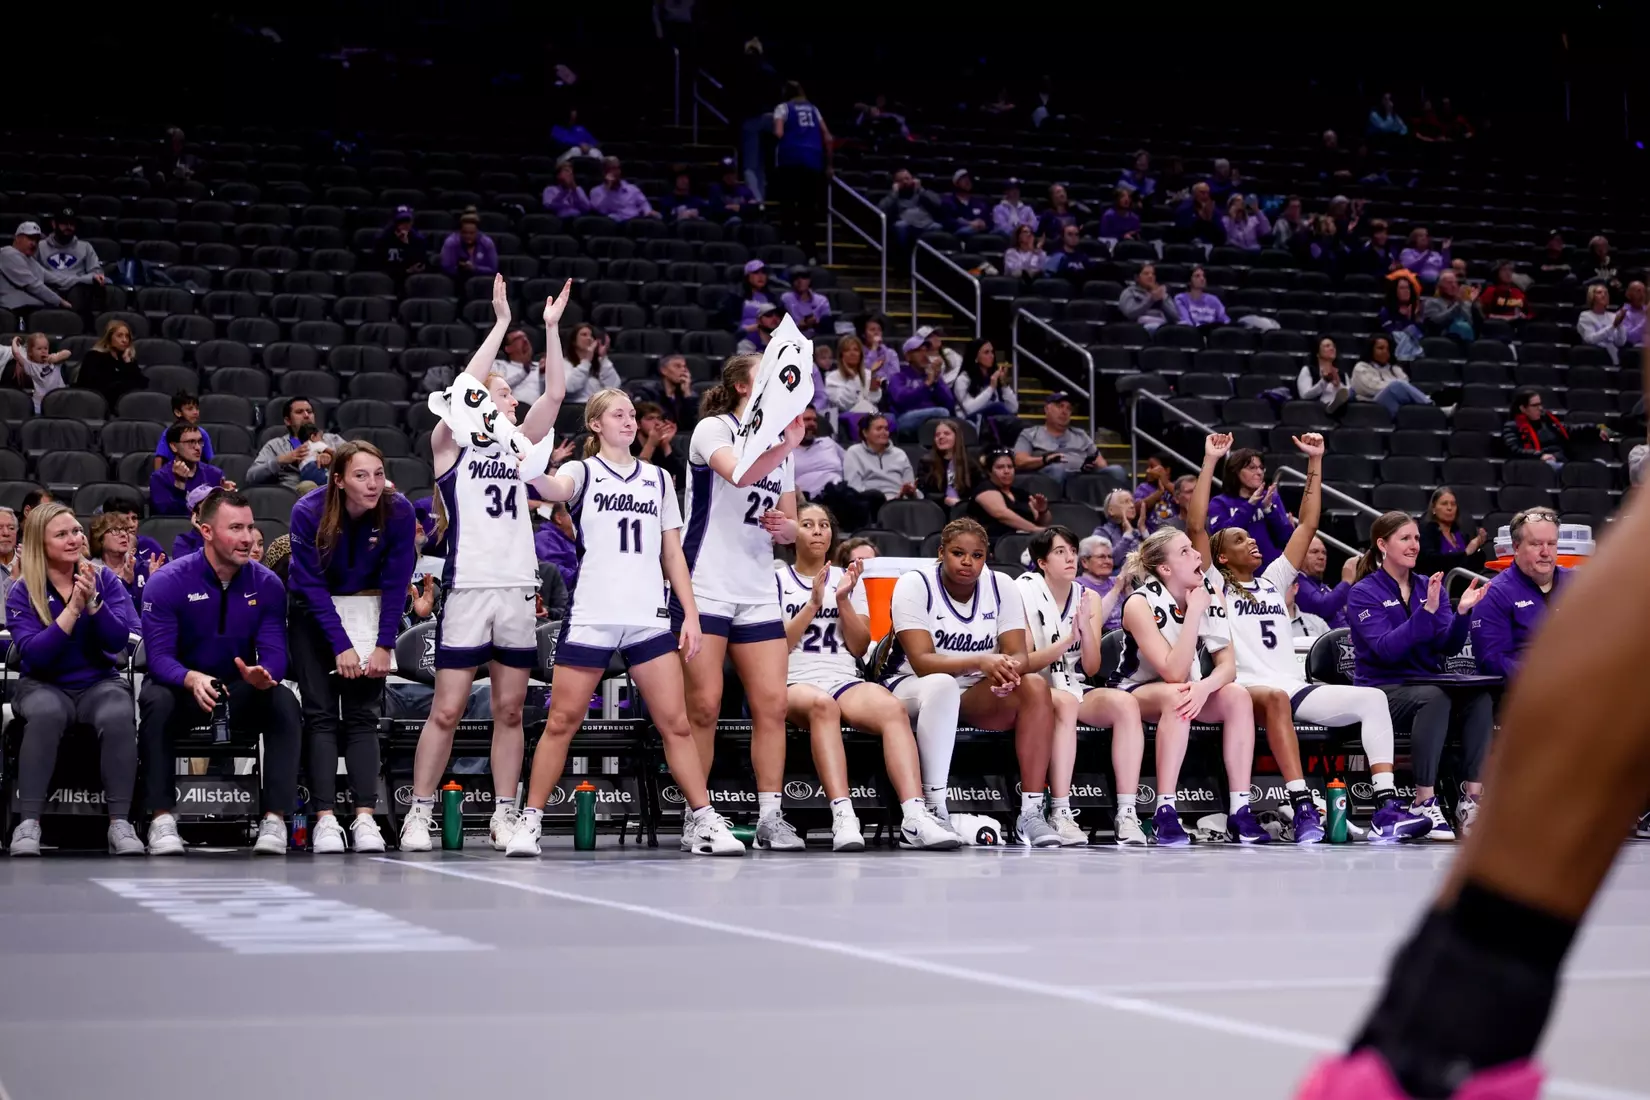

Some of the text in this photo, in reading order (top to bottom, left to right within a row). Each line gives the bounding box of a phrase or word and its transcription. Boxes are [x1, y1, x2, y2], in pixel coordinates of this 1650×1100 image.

[798, 111, 815, 127] 21
[484, 484, 518, 520] 34
[593, 493, 658, 517] Wildcats
[617, 517, 643, 554] 11
[803, 623, 838, 654] 24
[935, 629, 994, 652] Wildcats
[1259, 620, 1278, 649] 5
[49, 788, 107, 803] Allstat
[183, 788, 251, 803] Allstate
[567, 788, 632, 803] Atate
[707, 789, 756, 802] llstate
[946, 787, 1001, 801] Allstate
[1176, 788, 1214, 801] state
[1265, 786, 1321, 800] Allse
